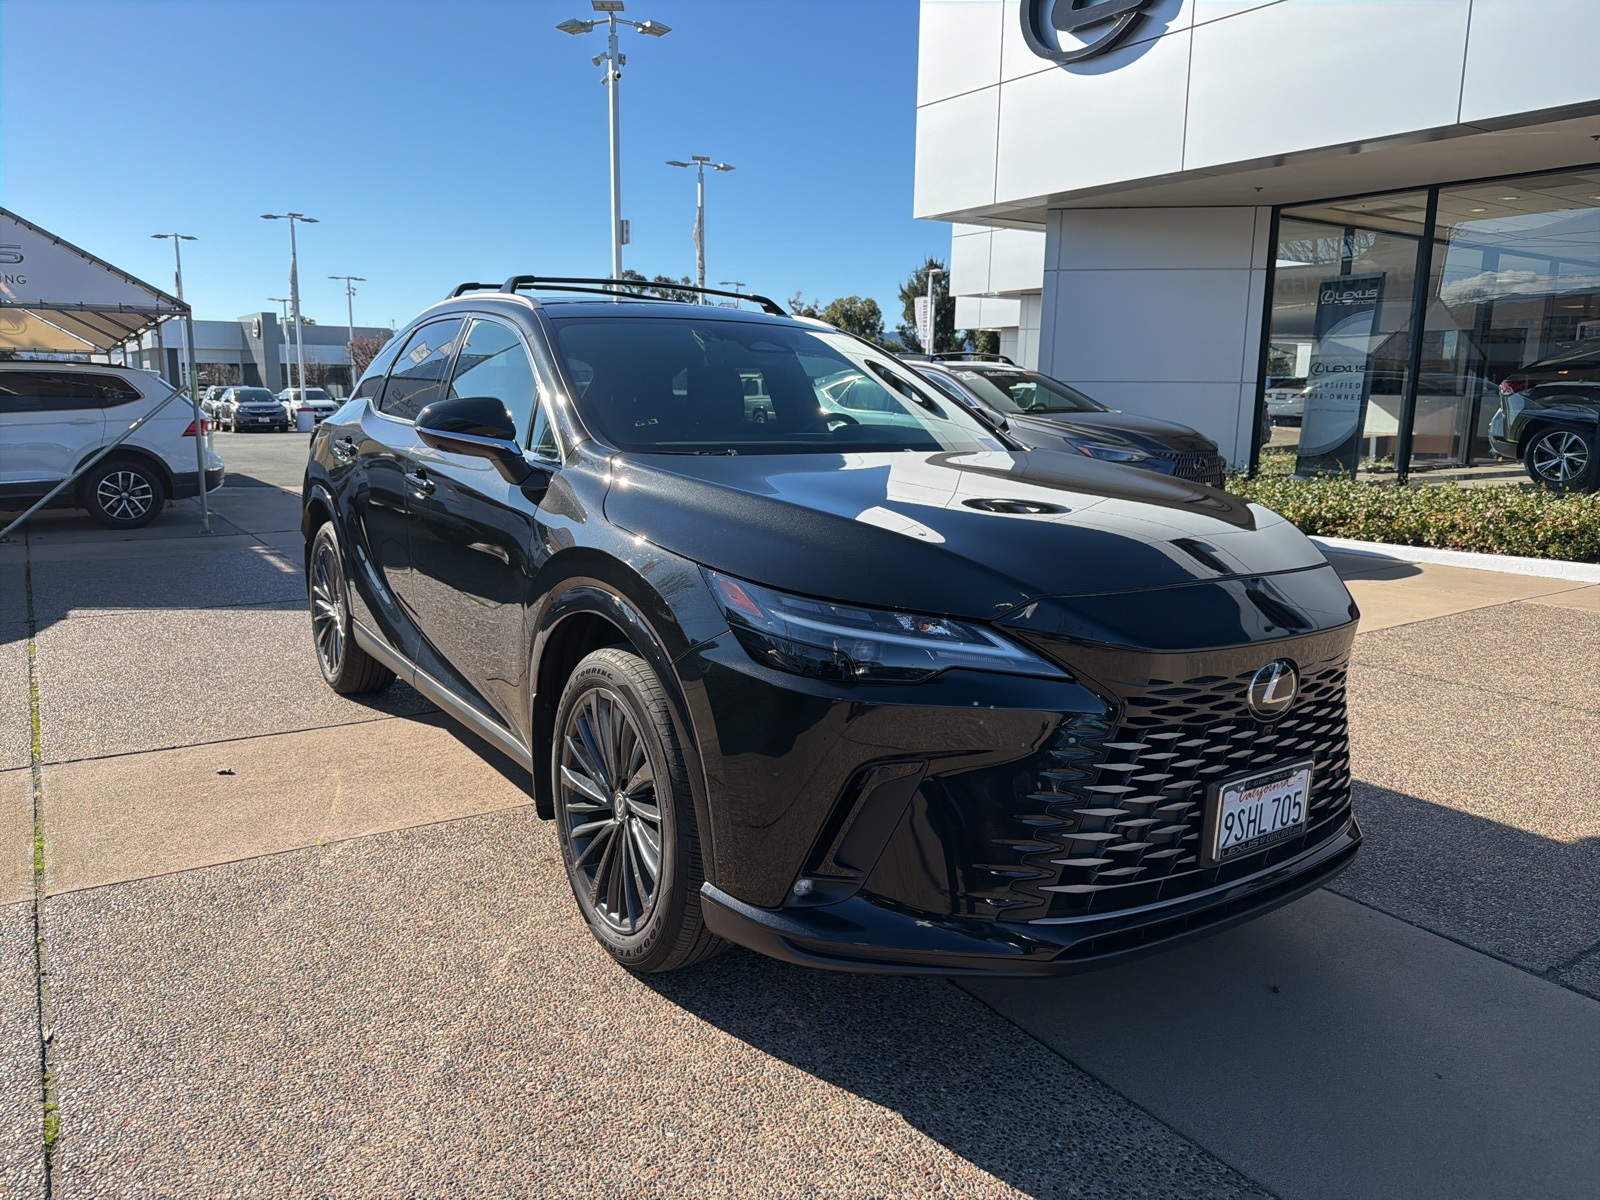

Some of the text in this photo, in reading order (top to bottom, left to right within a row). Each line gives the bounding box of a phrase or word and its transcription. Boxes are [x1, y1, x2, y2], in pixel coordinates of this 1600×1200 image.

[1335, 289, 1378, 300] LEXUS
[1325, 365, 1366, 373] LEXUS
[575, 667, 613, 681] TOURING
[1222, 791, 1303, 847] 9SHL 705
[1221, 840, 1259, 857] LEXUS
[601, 915, 662, 957] GOODYEAR
